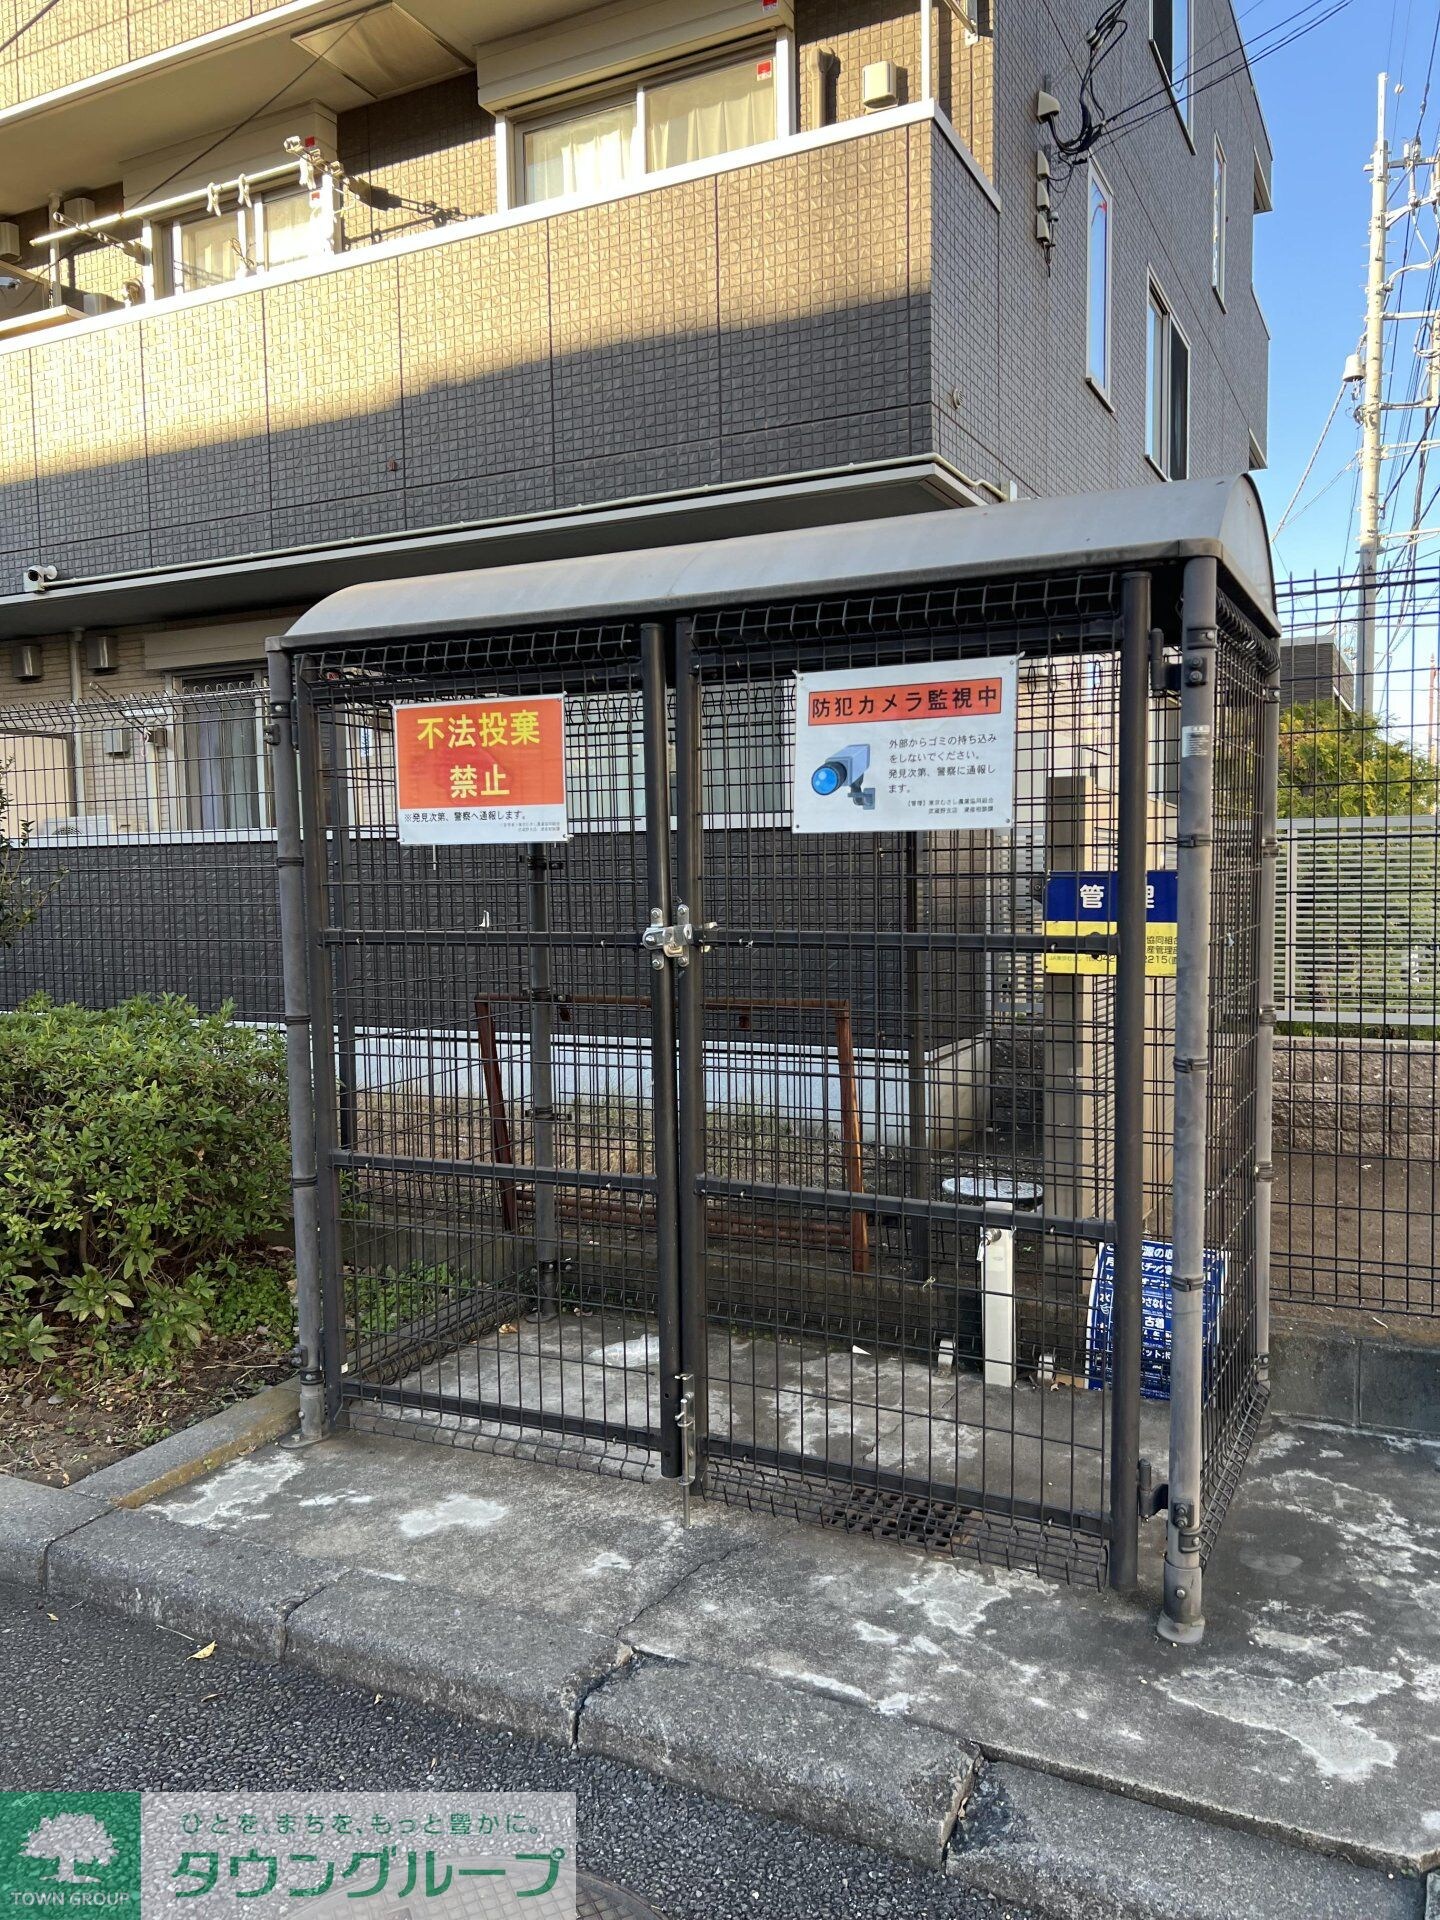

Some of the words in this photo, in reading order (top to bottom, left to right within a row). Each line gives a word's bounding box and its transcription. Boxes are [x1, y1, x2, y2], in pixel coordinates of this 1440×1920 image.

[811, 685, 998, 718] 防犯カメラ監視中
[416, 709, 541, 750] 不法投棄
[888, 733, 997, 749] 外部からゴミの持ち込み
[889, 751, 980, 764] をしないでください。
[888, 765, 996, 779] 発見次第、警察に通報し
[449, 763, 511, 799] 禁止
[888, 783, 911, 794] ます。
